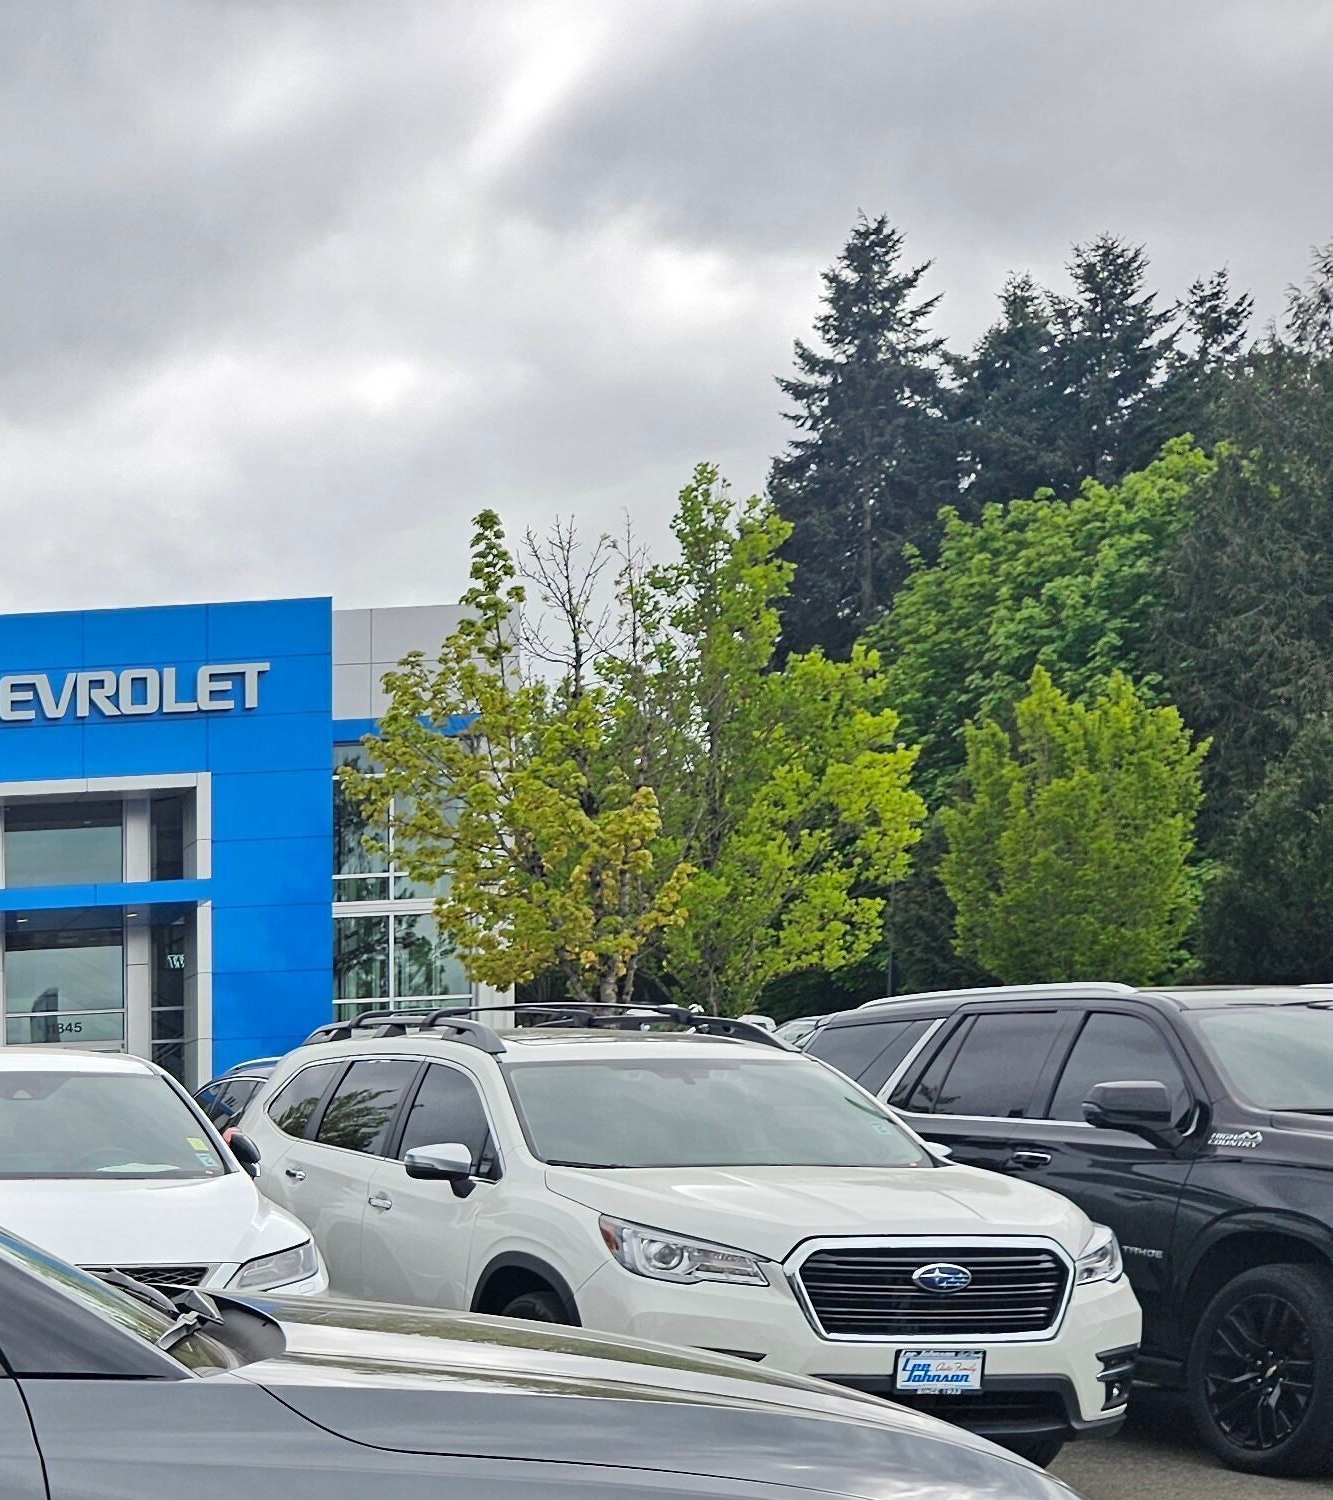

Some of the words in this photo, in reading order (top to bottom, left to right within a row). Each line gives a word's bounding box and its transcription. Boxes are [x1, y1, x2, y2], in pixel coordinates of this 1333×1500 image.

[1121, 1245, 1164, 1259] TAHOE
[901, 1358, 932, 1372] Lee
[901, 1369, 971, 1383] Johnson
